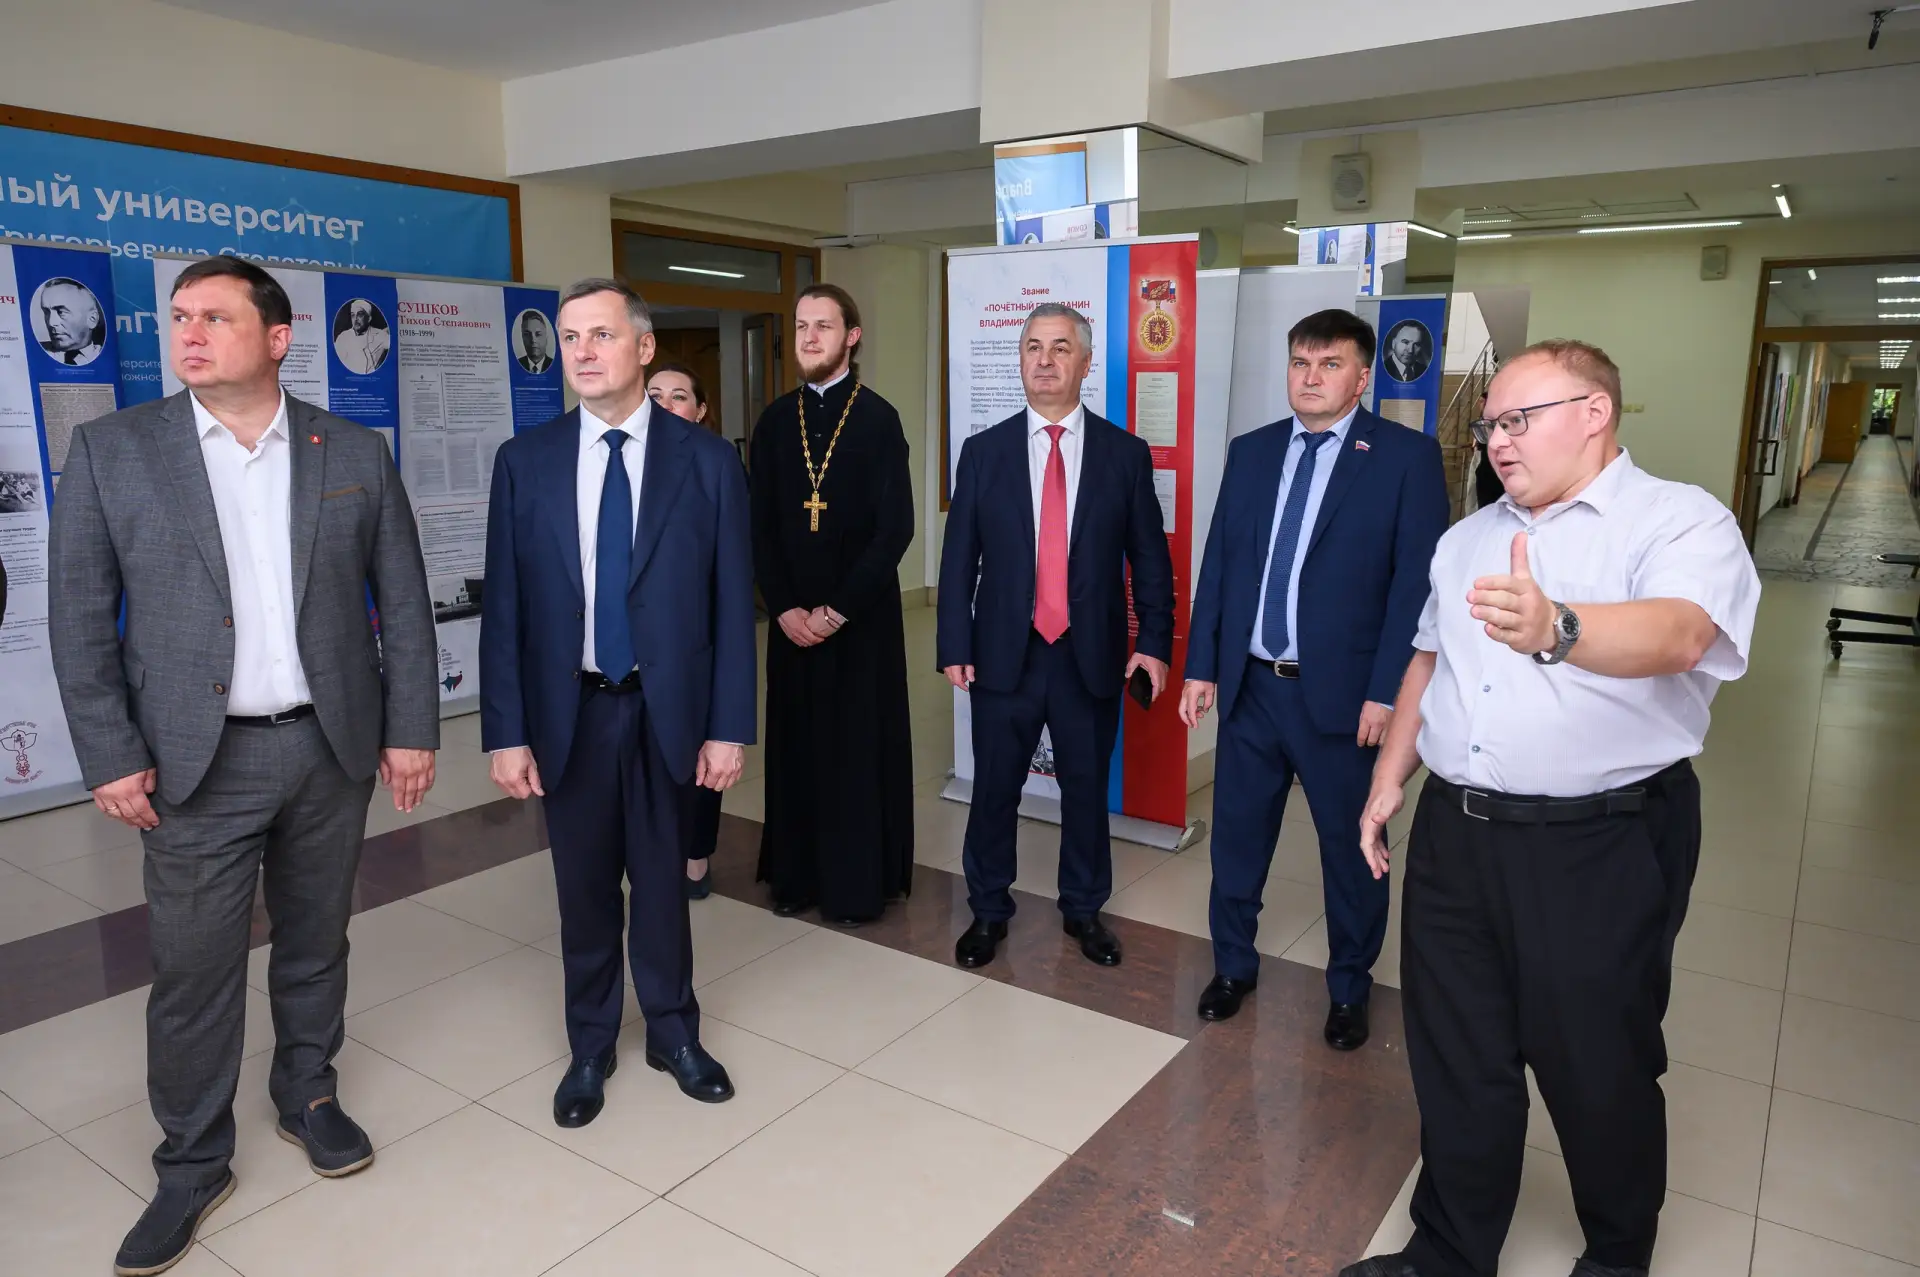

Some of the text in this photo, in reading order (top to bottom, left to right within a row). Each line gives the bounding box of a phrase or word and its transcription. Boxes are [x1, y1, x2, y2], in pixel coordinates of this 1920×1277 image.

[0, 173, 364, 242] ый университет
[1021, 287, 1050, 296] Звание
[398, 301, 459, 316] СУШКОВ
[984, 301, 1035, 312] «ПОЧЁТНЫЙ
[399, 315, 491, 329] Тихон Степанович
[980, 317, 1025, 328] ВЛАДИМИР
